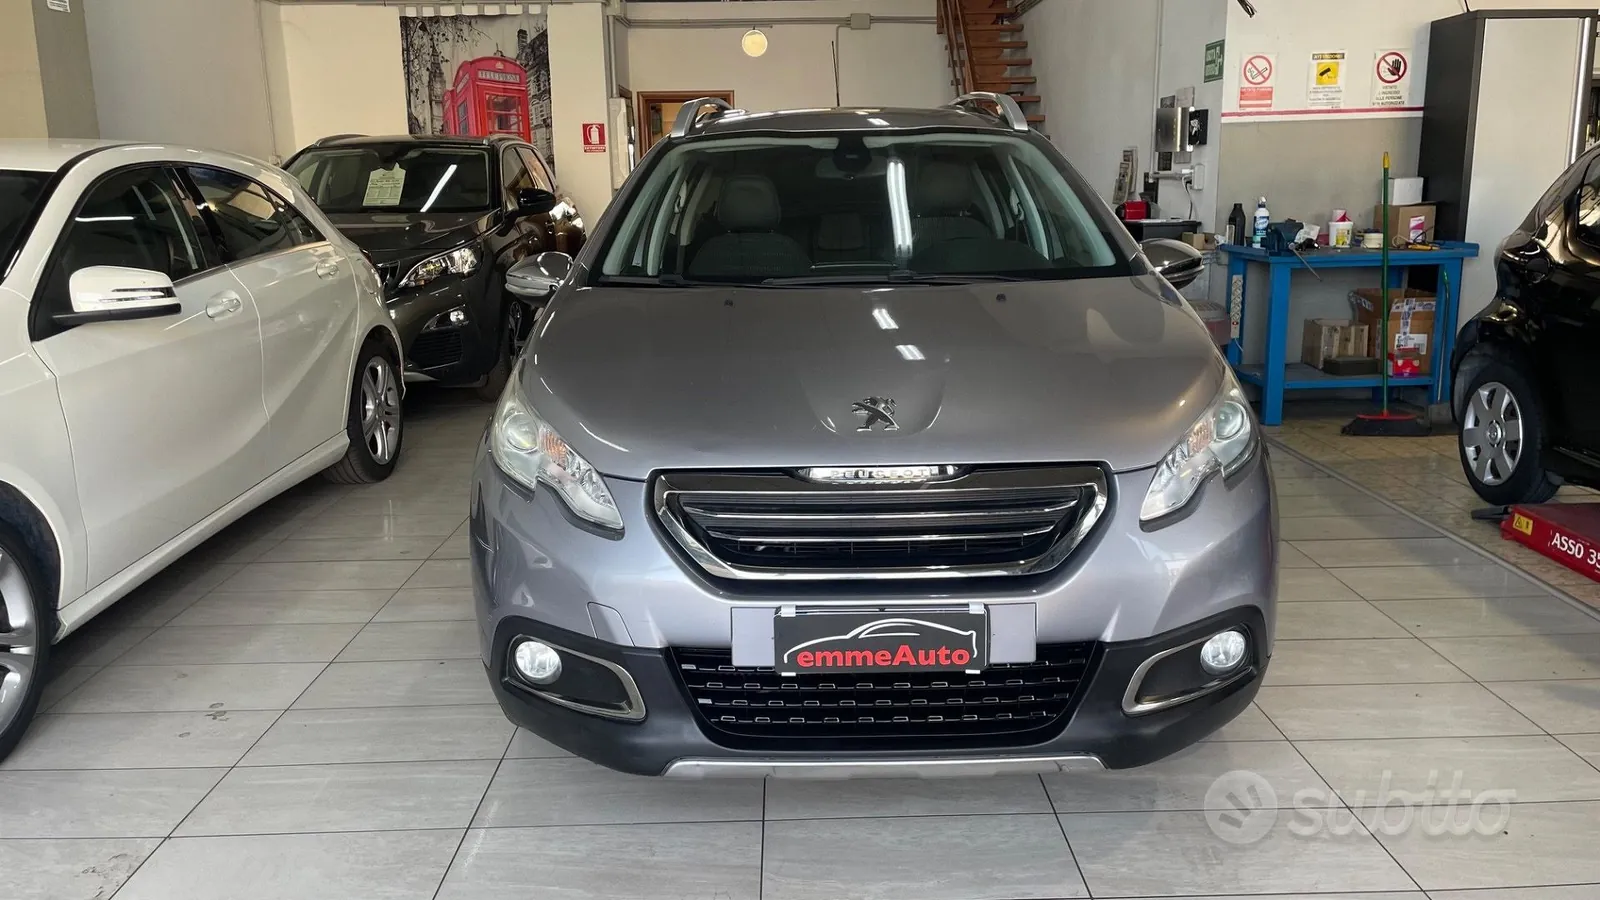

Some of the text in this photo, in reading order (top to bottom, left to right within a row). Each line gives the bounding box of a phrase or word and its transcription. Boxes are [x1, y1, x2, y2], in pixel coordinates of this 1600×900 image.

[829, 467, 929, 480] PEUGEOT
[1551, 532, 1584, 558] ASSO
[796, 644, 970, 667] emmeAuto
